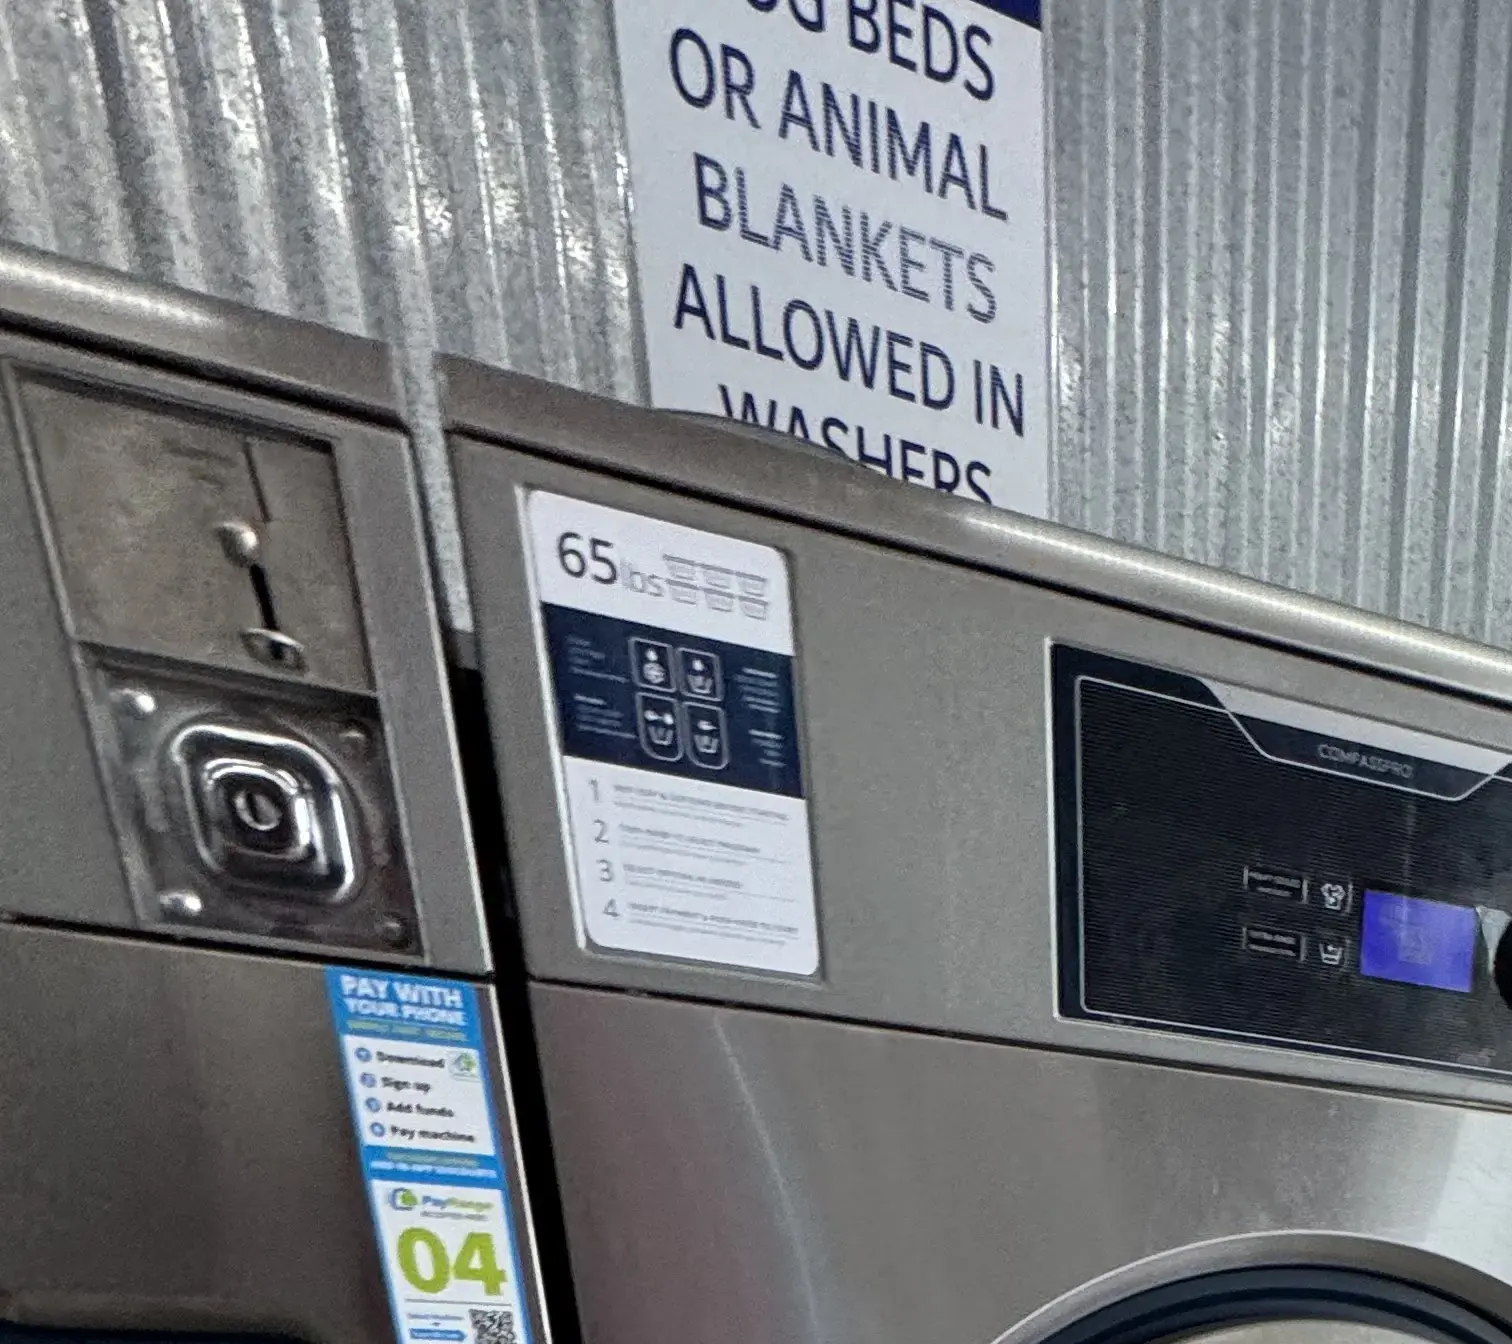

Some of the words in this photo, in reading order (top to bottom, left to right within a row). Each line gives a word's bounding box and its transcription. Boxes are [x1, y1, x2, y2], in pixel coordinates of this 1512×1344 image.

[849, 0, 994, 101] BEDS
[669, 28, 761, 130] OR
[779, 69, 1007, 221] ANIMAL
[694, 152, 996, 324] BLANKETS
[673, 263, 955, 410] ALLOWED
[974, 359, 1025, 438] IN
[594, 819, 609, 843] 2
[596, 859, 613, 882] 3
[603, 899, 620, 918] 4
[340, 974, 388, 999] PAY
[393, 982, 464, 1009] WITH
[397, 1226, 509, 1297] 04
